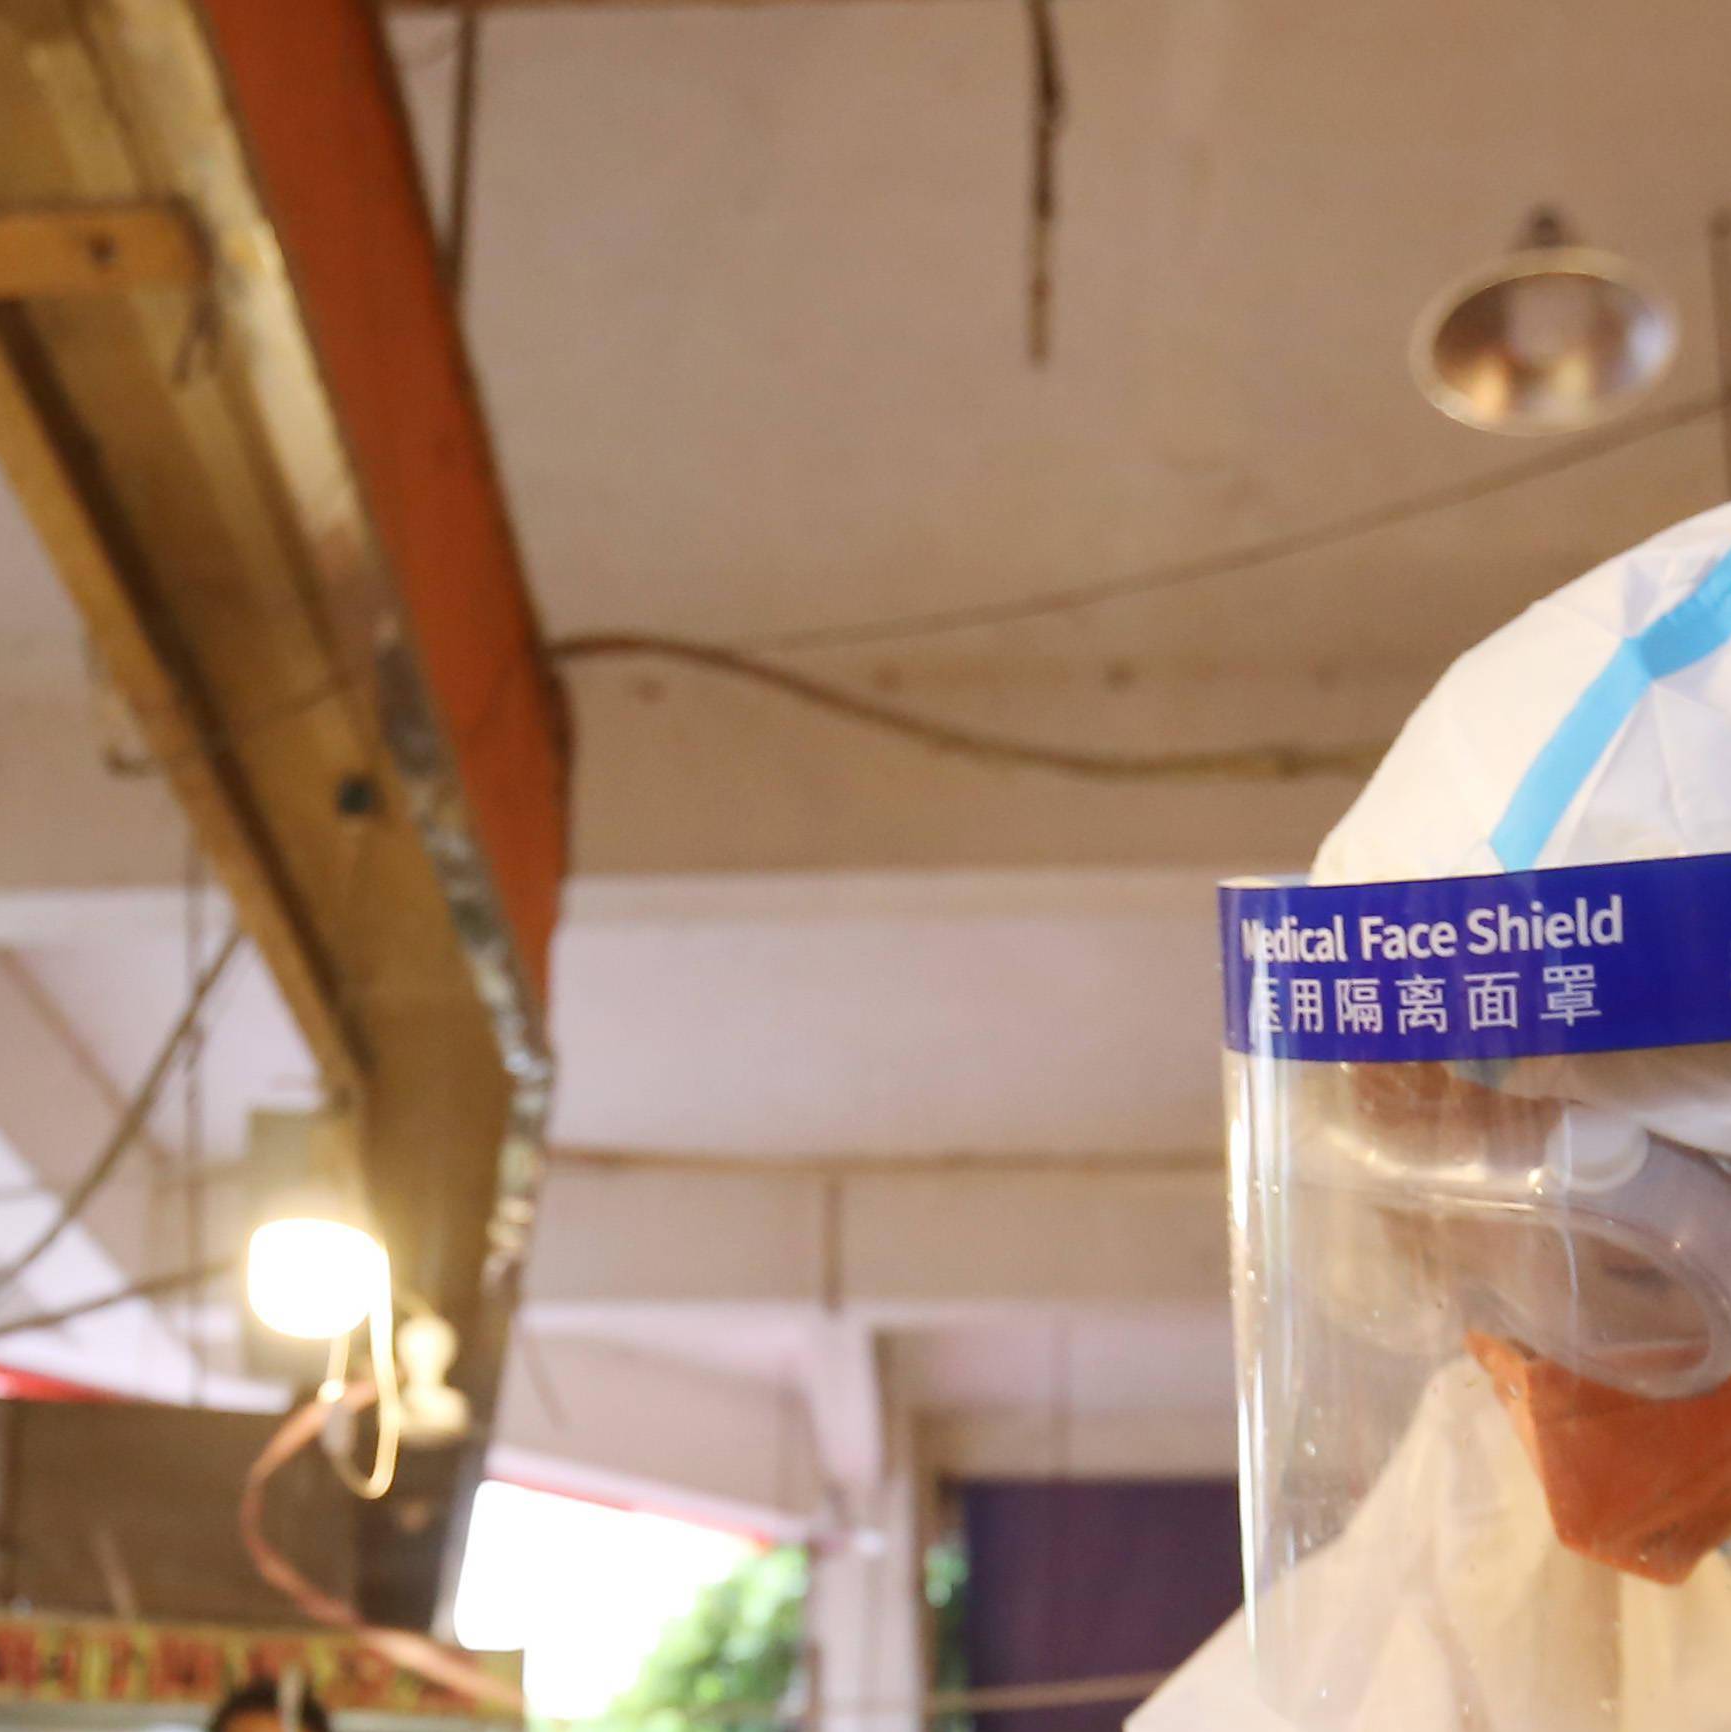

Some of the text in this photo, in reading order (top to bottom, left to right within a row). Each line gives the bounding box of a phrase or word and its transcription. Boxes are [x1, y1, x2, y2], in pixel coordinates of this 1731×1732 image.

[1241, 894, 1625, 963] Medical Face Shield
